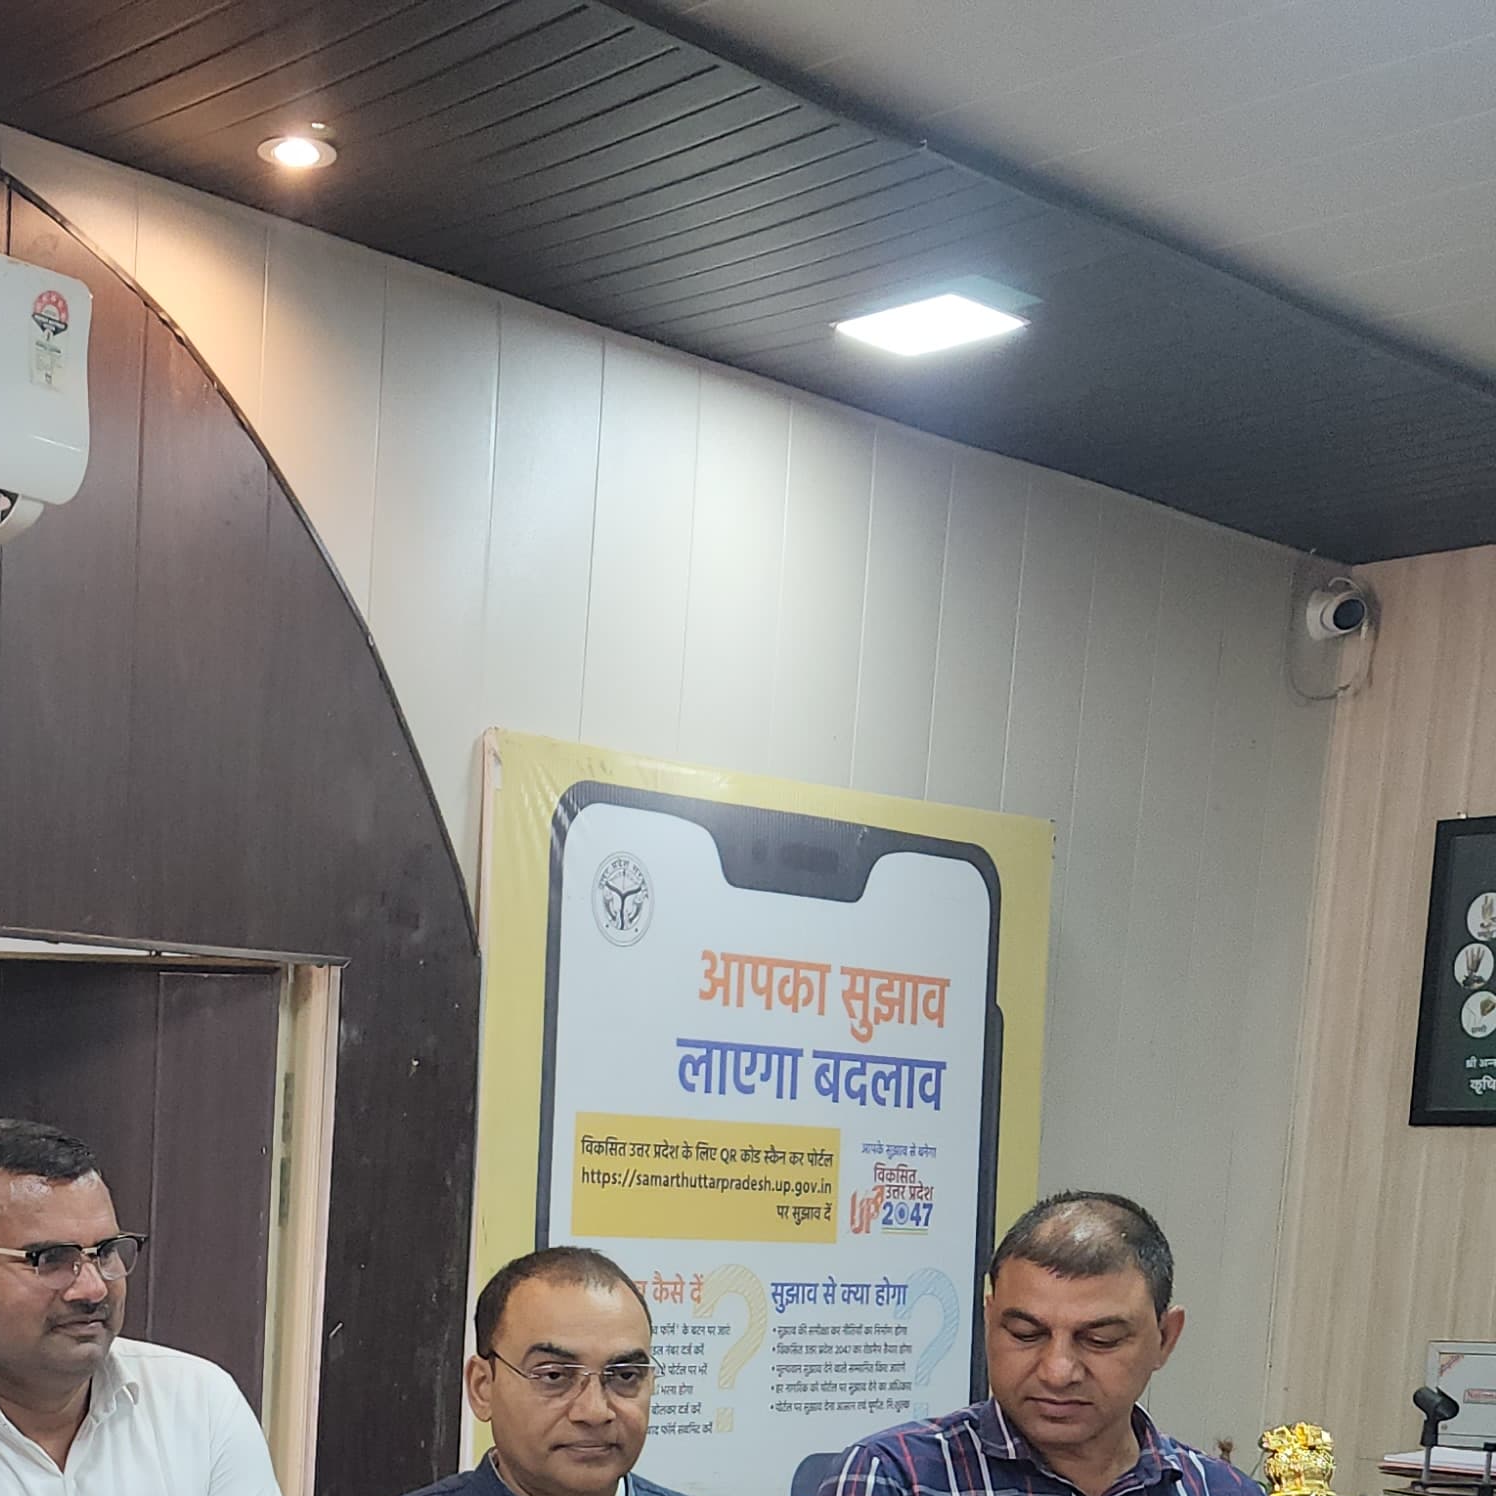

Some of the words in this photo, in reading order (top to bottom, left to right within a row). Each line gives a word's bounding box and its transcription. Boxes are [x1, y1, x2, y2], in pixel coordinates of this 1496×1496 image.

[698, 950, 831, 1015] आपका
[840, 966, 951, 1043] सुझाव
[676, 1038, 804, 1100] लाएगा
[812, 1049, 947, 1111] बदलाव
[581, 1135, 627, 1157] विकसित
[629, 1141, 650, 1158] उत्तर
[654, 1139, 679, 1160] प्रदेश
[682, 1139, 693, 1160] के
[696, 1141, 717, 1162] लिए
[720, 1147, 737, 1164] QR
[740, 1144, 761, 1164] कोड
[763, 1144, 786, 1167] स्कैन
[789, 1150, 805, 1167] कर
[807, 1147, 834, 1168] पोर्टल
[581, 1166, 832, 1196] https://samarthuttarpradesh.up.gov.in
[874, 1162, 917, 1183] विकसित
[885, 1184, 906, 1200] उत्तर
[909, 1180, 934, 1201] प्रदेश
[776, 1204, 789, 1221] पर
[792, 1204, 821, 1226] सुझाव
[823, 1202, 832, 1221] दें
[652, 1270, 685, 1304] कैसे
[689, 1273, 704, 1304] दें
[770, 1282, 819, 1313] सुझाव
[822, 1276, 837, 1305] से
[840, 1283, 871, 1305] क्या
[875, 1276, 908, 1306] होगा
